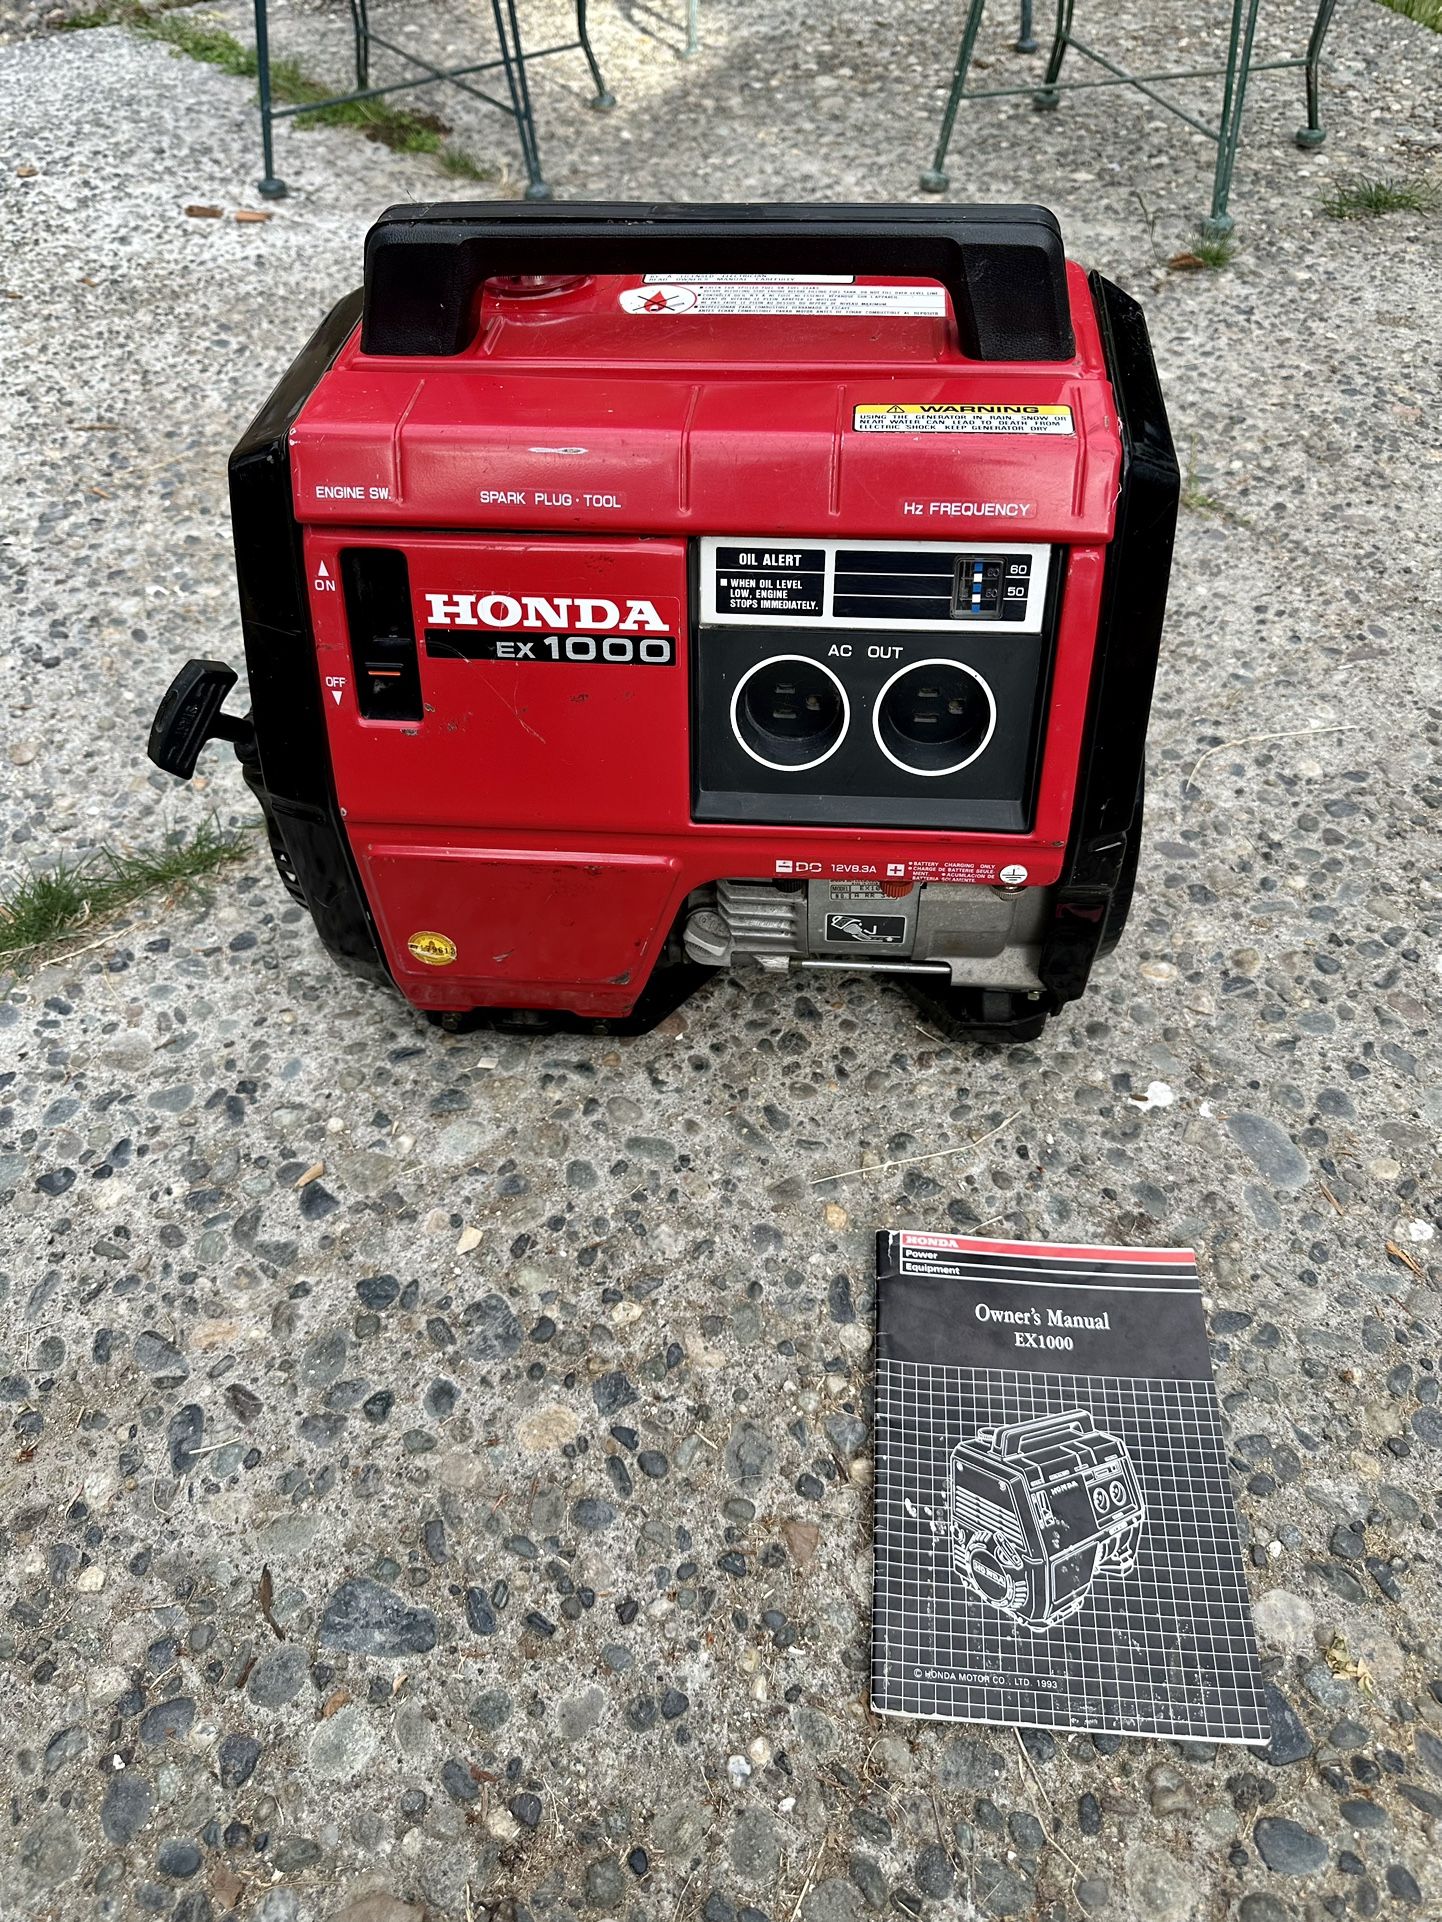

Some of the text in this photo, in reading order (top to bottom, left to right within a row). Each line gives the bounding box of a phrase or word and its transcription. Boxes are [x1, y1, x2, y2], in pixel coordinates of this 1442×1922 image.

[920, 406, 1039, 414] WARNING
[315, 486, 391, 500] ENGINE SW.
[480, 491, 526, 505] SPARK
[904, 502, 1031, 516] Hz FREQUENCY
[738, 553, 802, 567] OIL ALERT
[1010, 564, 1027, 575] 60
[314, 579, 336, 592] ON
[730, 578, 802, 589] WHEN OIL LEVEL
[755, 589, 788, 599] ENGINE
[1007, 586, 1025, 597] 50
[729, 599, 819, 611] STOPS IMMEDIATELY.
[425, 593, 670, 632] HONDA
[496, 636, 671, 663] EX 1000
[827, 644, 904, 660] AC OUT
[325, 676, 346, 688] OFF
[795, 862, 877, 874] DC 12V8.3A
[905, 1236, 959, 1248] HONDA
[905, 1249, 938, 1260] Power
[905, 1262, 960, 1275] Equipment
[975, 1303, 1111, 1331] Owner's Manual
[1014, 1331, 1074, 1351] EX1000
[925, 1670, 956, 1680] HONDA
[958, 1673, 990, 1683] MOTOR
[1036, 1679, 1058, 1689] 1993
